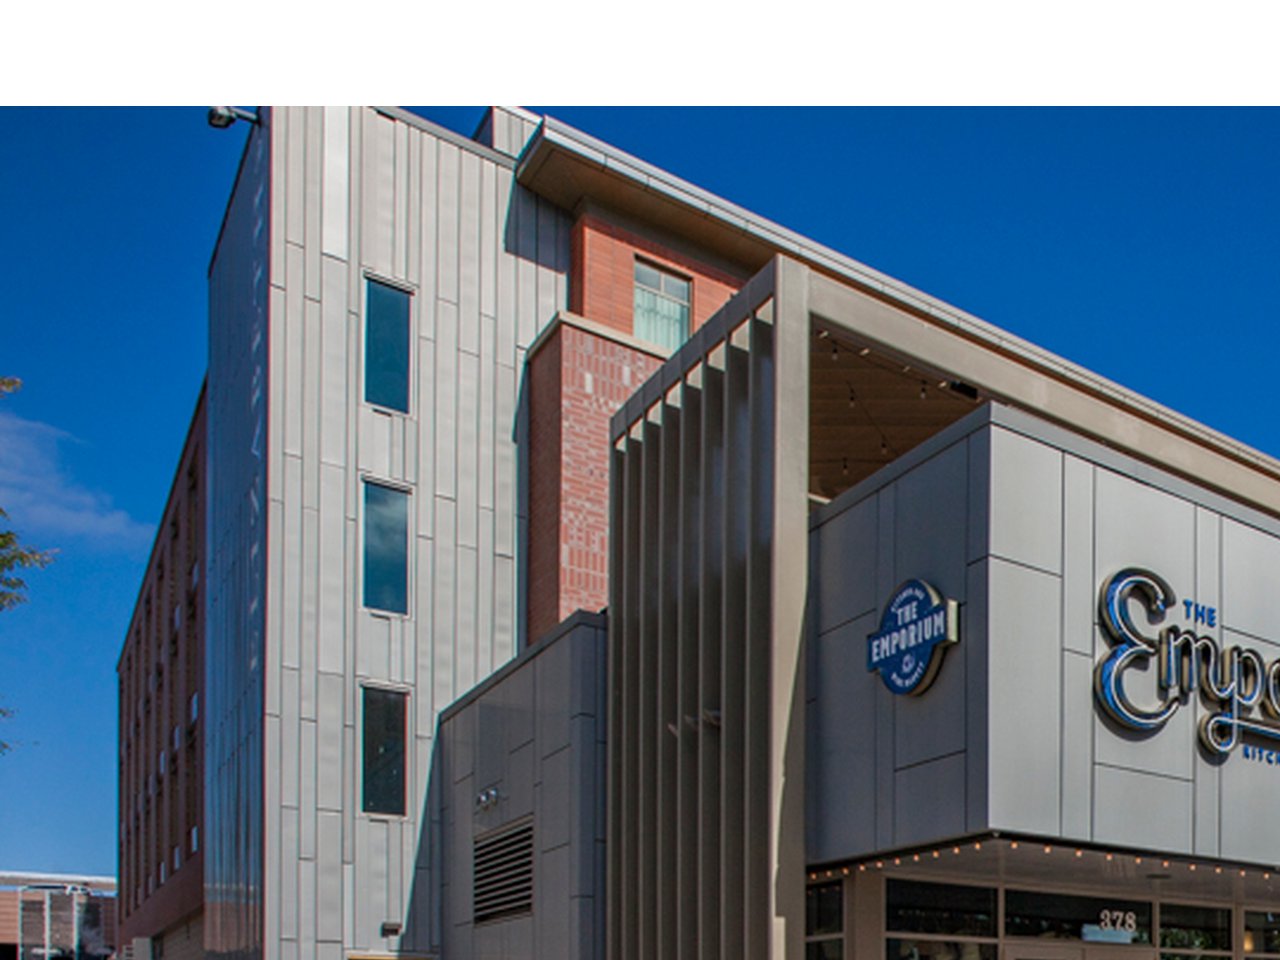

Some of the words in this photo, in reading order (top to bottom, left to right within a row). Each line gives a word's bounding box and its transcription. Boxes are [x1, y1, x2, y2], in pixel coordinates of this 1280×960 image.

[897, 601, 918, 626] THE
[1183, 598, 1217, 628] THE
[871, 610, 945, 663] EMPORIUM
[1100, 910, 1137, 932] 378
